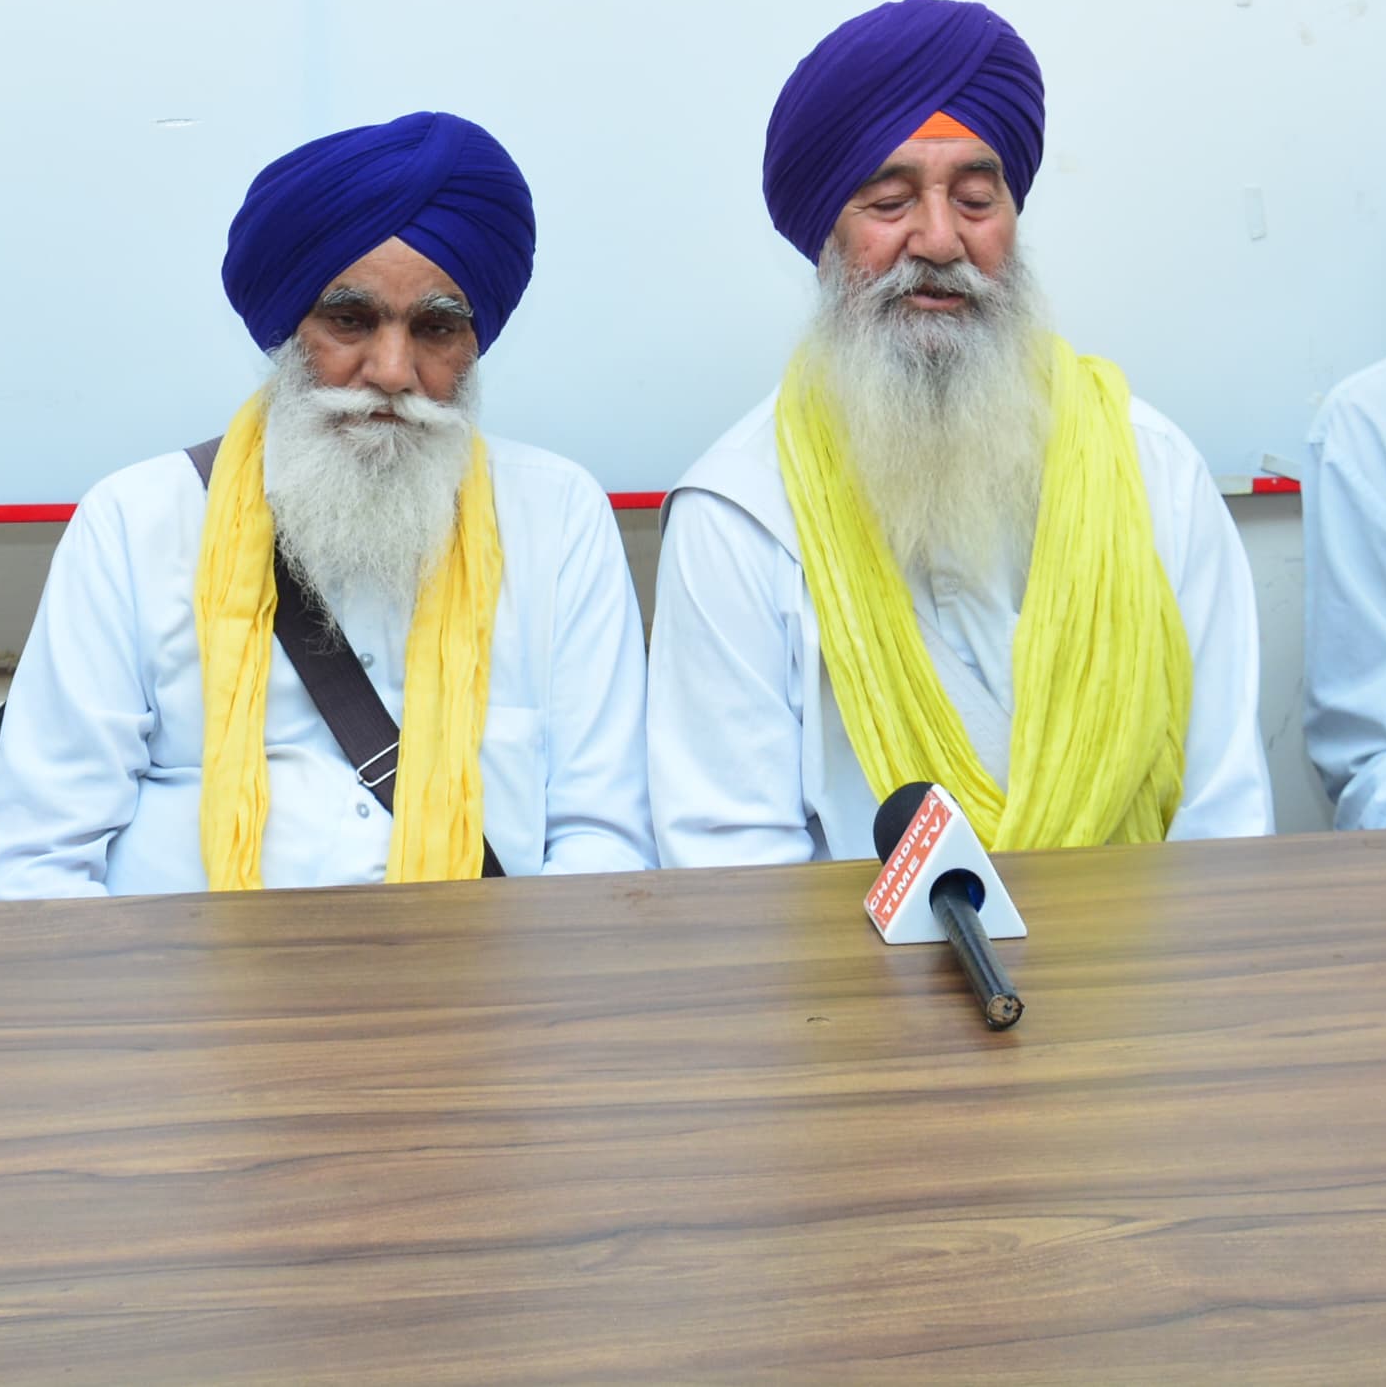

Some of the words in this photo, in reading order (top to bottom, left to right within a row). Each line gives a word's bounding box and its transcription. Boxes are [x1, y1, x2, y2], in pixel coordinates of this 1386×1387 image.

[870, 798, 939, 911] CHARDIKLA
[882, 855, 920, 914] TIME
[920, 816, 940, 848] TV
